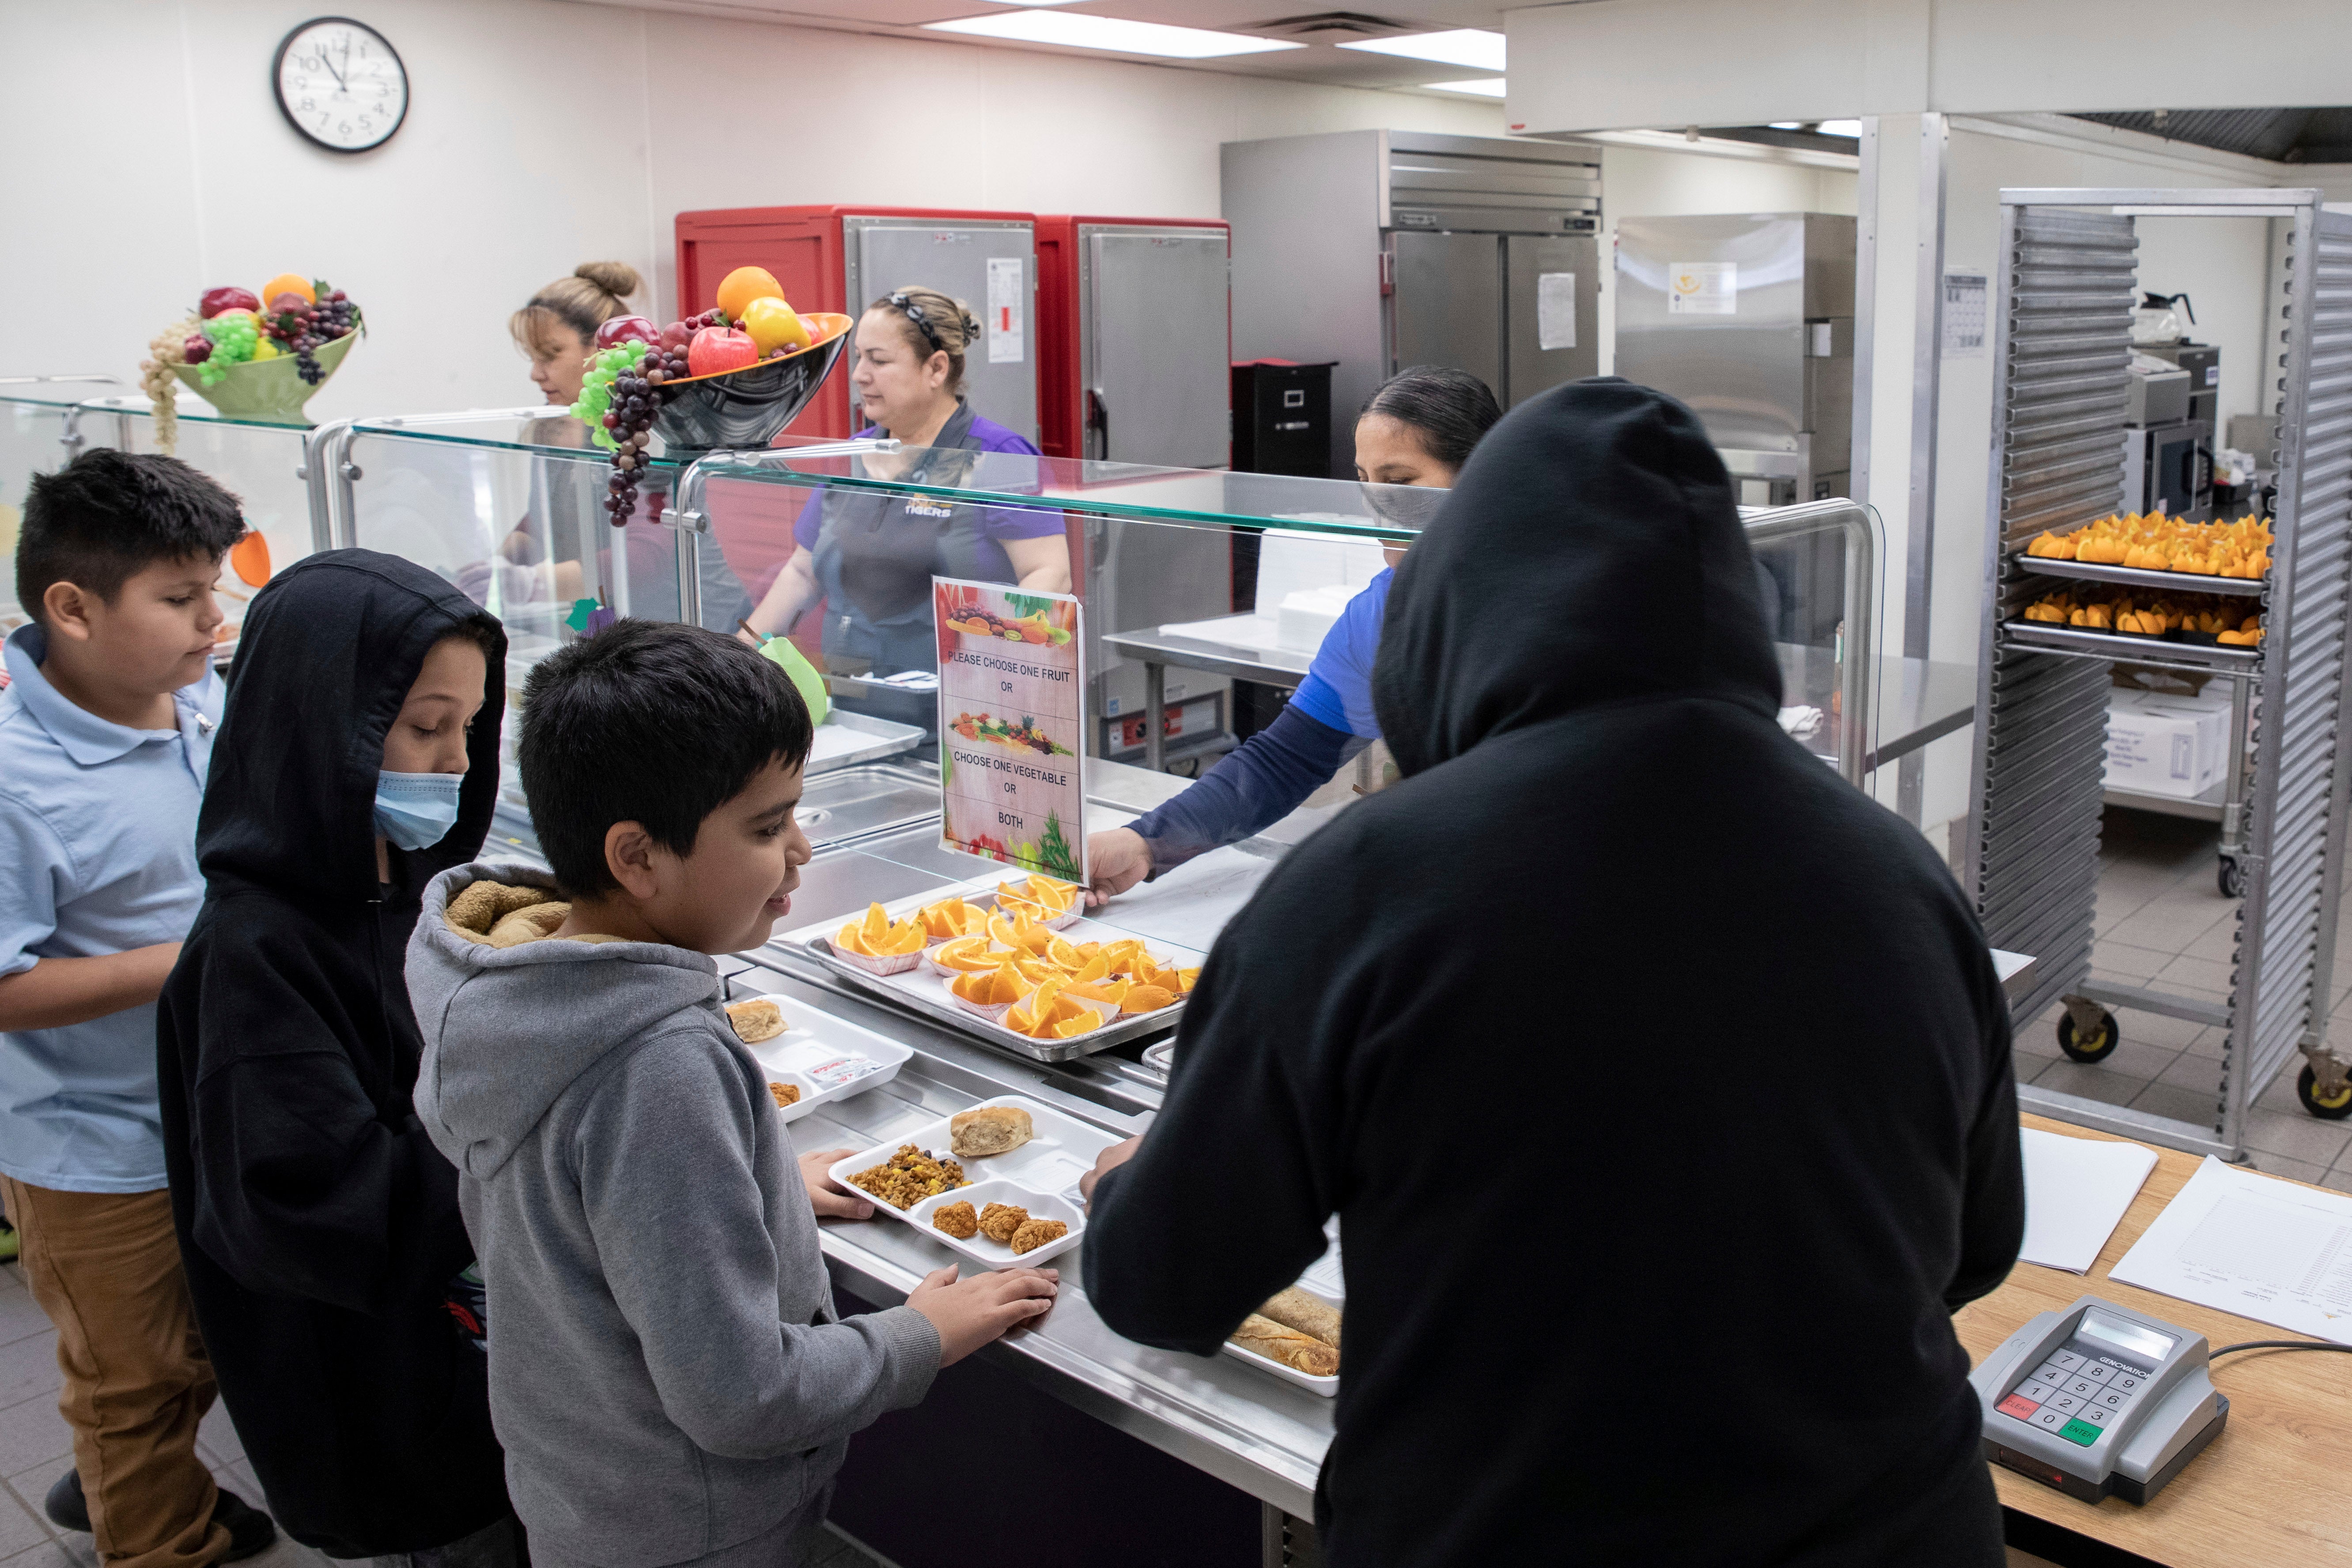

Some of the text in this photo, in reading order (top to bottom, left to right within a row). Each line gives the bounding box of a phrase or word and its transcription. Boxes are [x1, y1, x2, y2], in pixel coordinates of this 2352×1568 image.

[299, 56, 321, 73] 10
[371, 62, 382, 77] 2
[294, 76, 307, 90] 9
[378, 81, 389, 98] 3
[300, 97, 316, 113] 8
[372, 102, 385, 115] 4
[318, 111, 330, 127] 7
[358, 114, 372, 130] 5
[338, 120, 352, 135] 6
[905, 505, 951, 518] TIGERS
[948, 651, 1070, 682] PLEASE CHOOSE ONE FRUIT
[1001, 681, 1013, 693] OR
[954, 751, 1066, 786] CHOOSE ONE VEGETABLE
[1004, 782, 1017, 794] OR
[998, 812, 1023, 829] BOTH
[2061, 1355, 2074, 1364] 7
[2091, 1367, 2103, 1376] 8
[2076, 1383, 2088, 1391] 5
[2122, 1379, 2135, 1388] 9
[2058, 1398, 2072, 1408] 2
[2107, 1395, 2120, 1404] 6
[2005, 1400, 2031, 1413] CLEAR
[2043, 1414, 2055, 1424] 0
[2091, 1411, 2103, 1420] 3
[2067, 1424, 2094, 1439] ENTER
